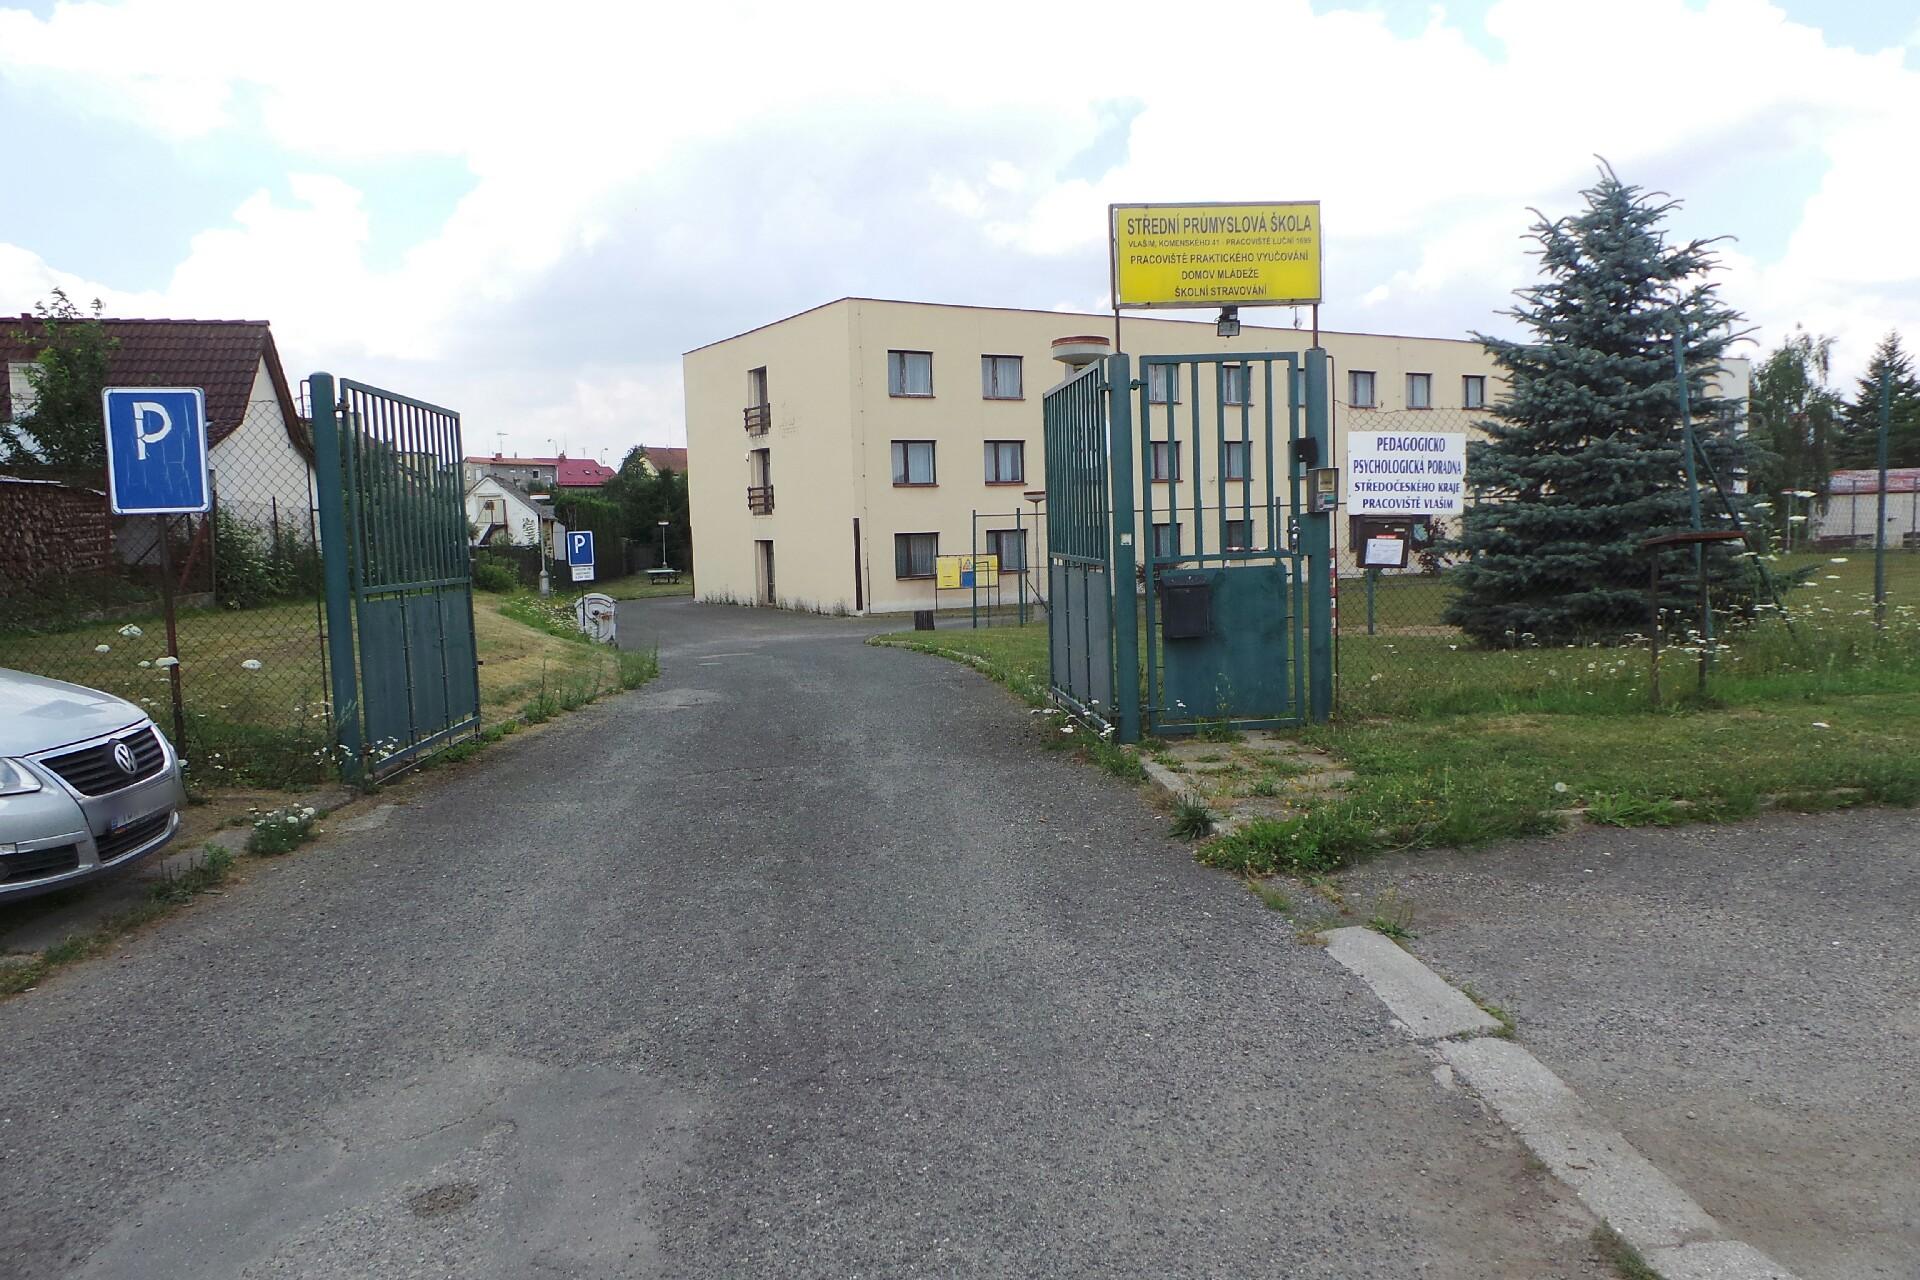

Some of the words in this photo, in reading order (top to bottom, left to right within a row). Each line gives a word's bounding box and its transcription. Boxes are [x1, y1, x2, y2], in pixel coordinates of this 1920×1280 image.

[1127, 213, 1180, 235] STŘEDNÍ
[1183, 211, 1267, 234] PRŮMYSLOVÁ
[1270, 211, 1312, 232] ŠKOLA
[1159, 238, 1210, 247] KOMENSKÉHO
[1130, 252, 1188, 264] PRACOVIŠTĚ
[1190, 250, 1254, 263] PRAKTICKÉHO
[1256, 249, 1309, 262] VYUČOVÁNÍ
[1181, 270, 1215, 280] DOMOV
[1217, 267, 1259, 279] MLÁDEŽE
[1174, 284, 1209, 297] ŠKOLNÍ
[1210, 283, 1267, 296] STRAVOVÁNÍ
[132, 401, 172, 460] P
[1377, 437, 1446, 452] PEDAGOGICKO
[1353, 455, 1425, 474] PSYCHOLOGICKÁ
[1427, 460, 1462, 475] PORADNA
[1354, 478, 1435, 492] STŘEDOČESKÉHO
[1437, 482, 1460, 494] KRAJE
[1362, 495, 1421, 509] PRACOVIŠTĚ
[574, 534, 586, 554] P
